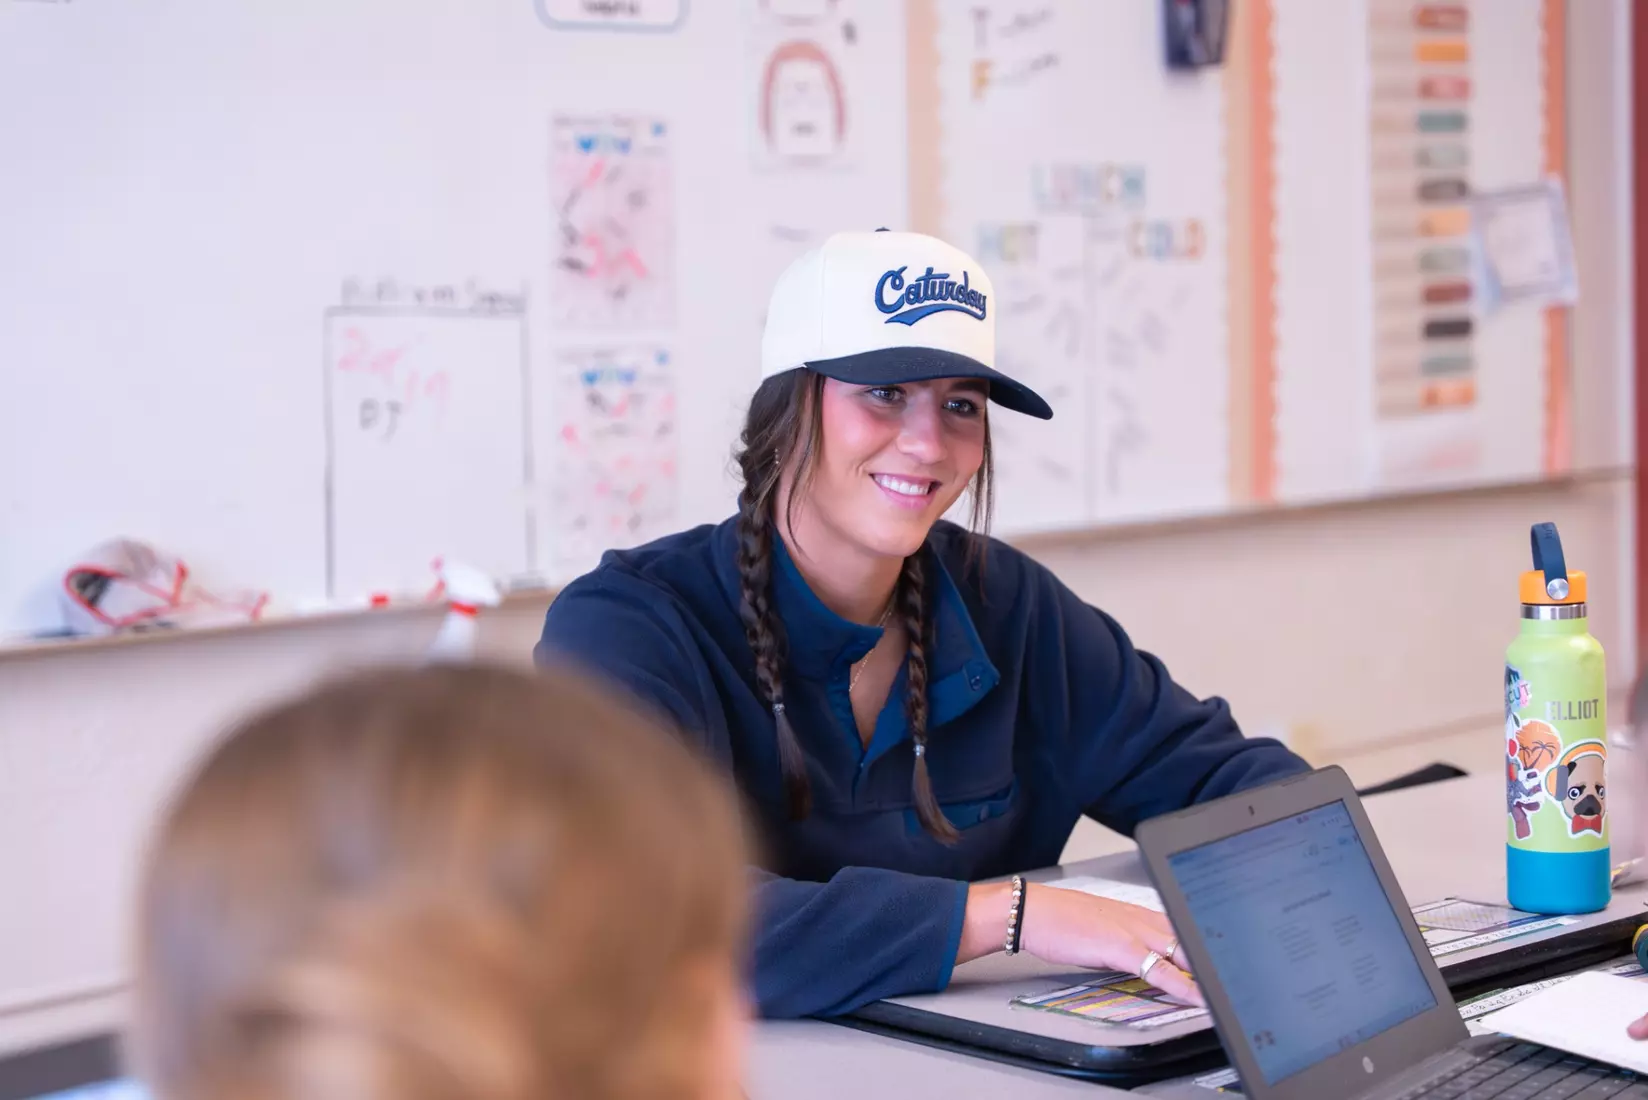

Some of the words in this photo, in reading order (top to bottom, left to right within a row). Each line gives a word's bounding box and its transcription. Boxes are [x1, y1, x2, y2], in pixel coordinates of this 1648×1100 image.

[1126, 217, 1205, 260] COLD
[875, 265, 987, 321] Caturday
[1546, 699, 1599, 720] ELLIOT
